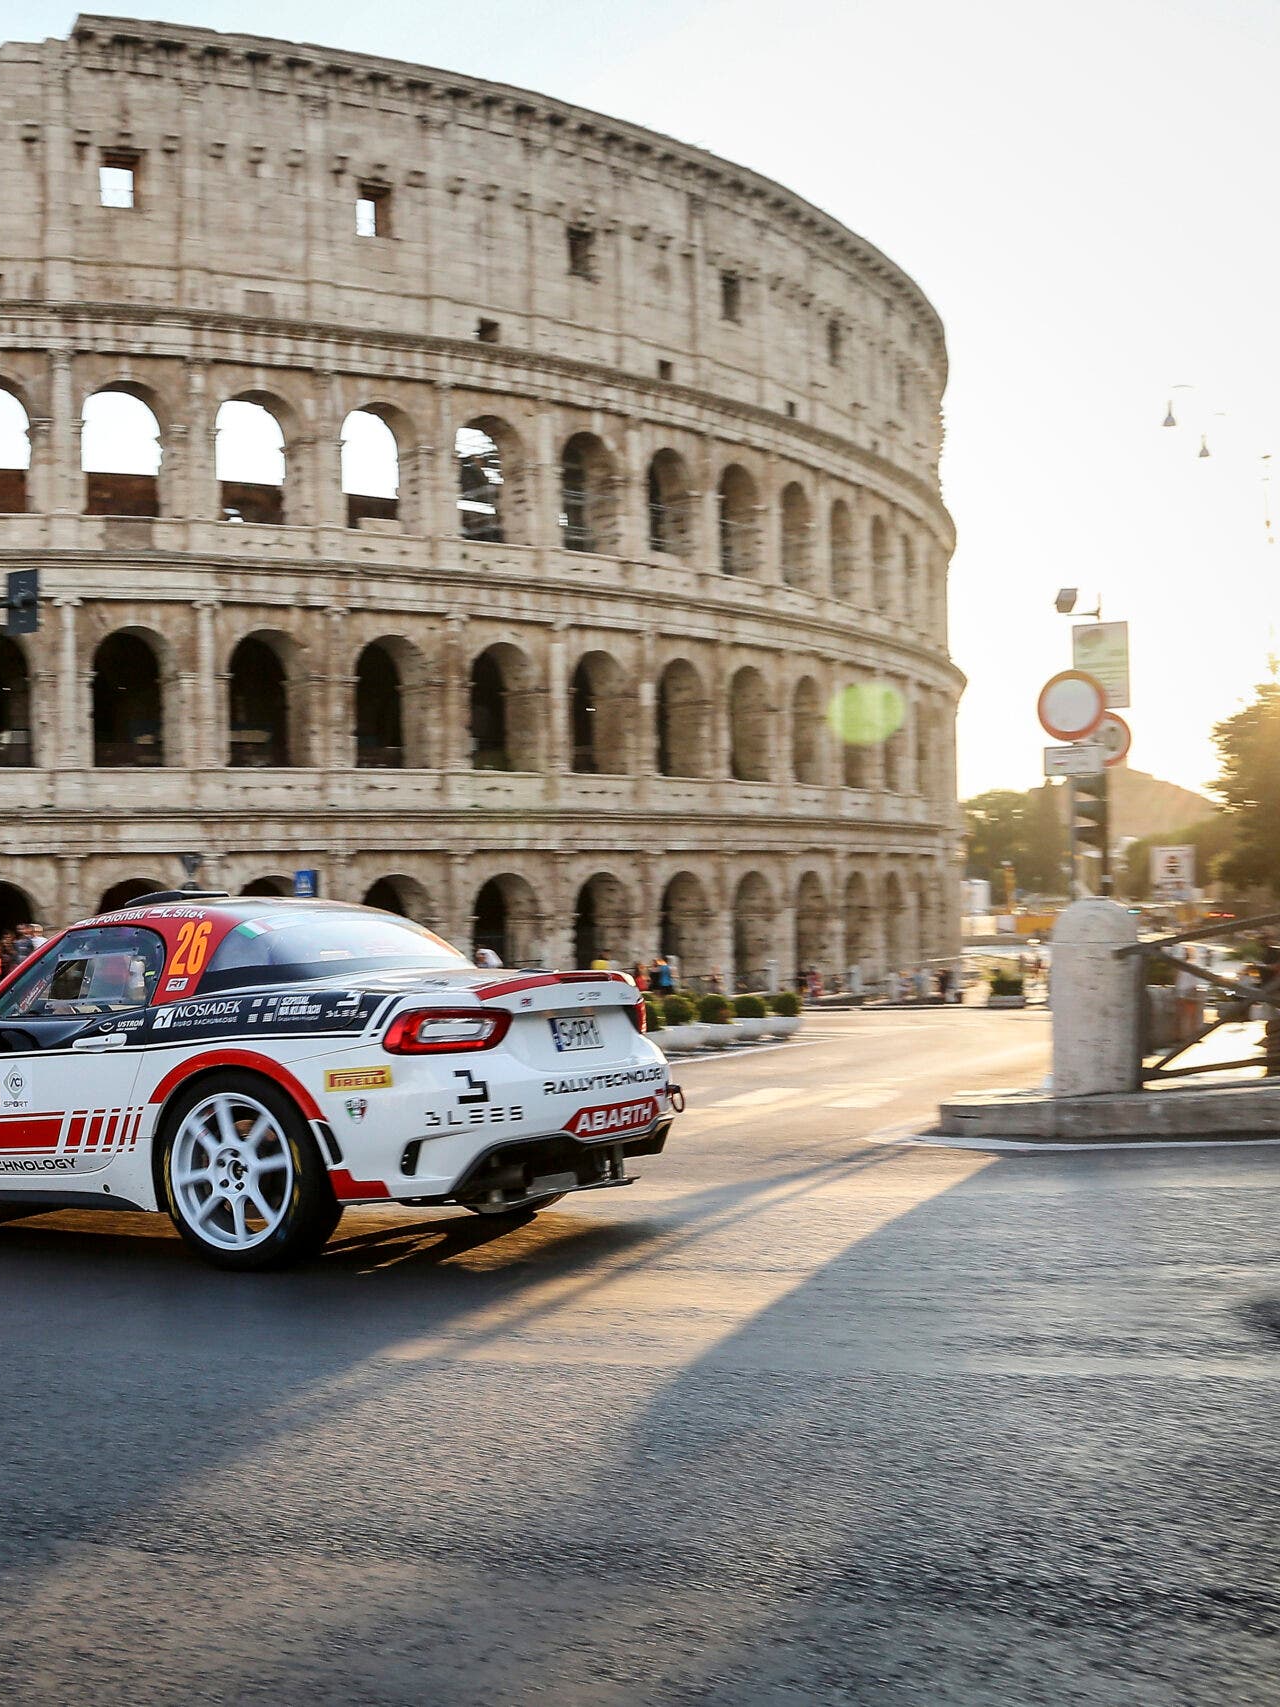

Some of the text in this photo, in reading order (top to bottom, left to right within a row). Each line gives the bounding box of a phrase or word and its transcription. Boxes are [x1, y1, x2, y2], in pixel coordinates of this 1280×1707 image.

[168, 921, 212, 975] 26
[175, 1000, 243, 1018] NOSIADEK
[329, 1069, 387, 1088] PIRELLI
[575, 1102, 654, 1134] ABARTH
